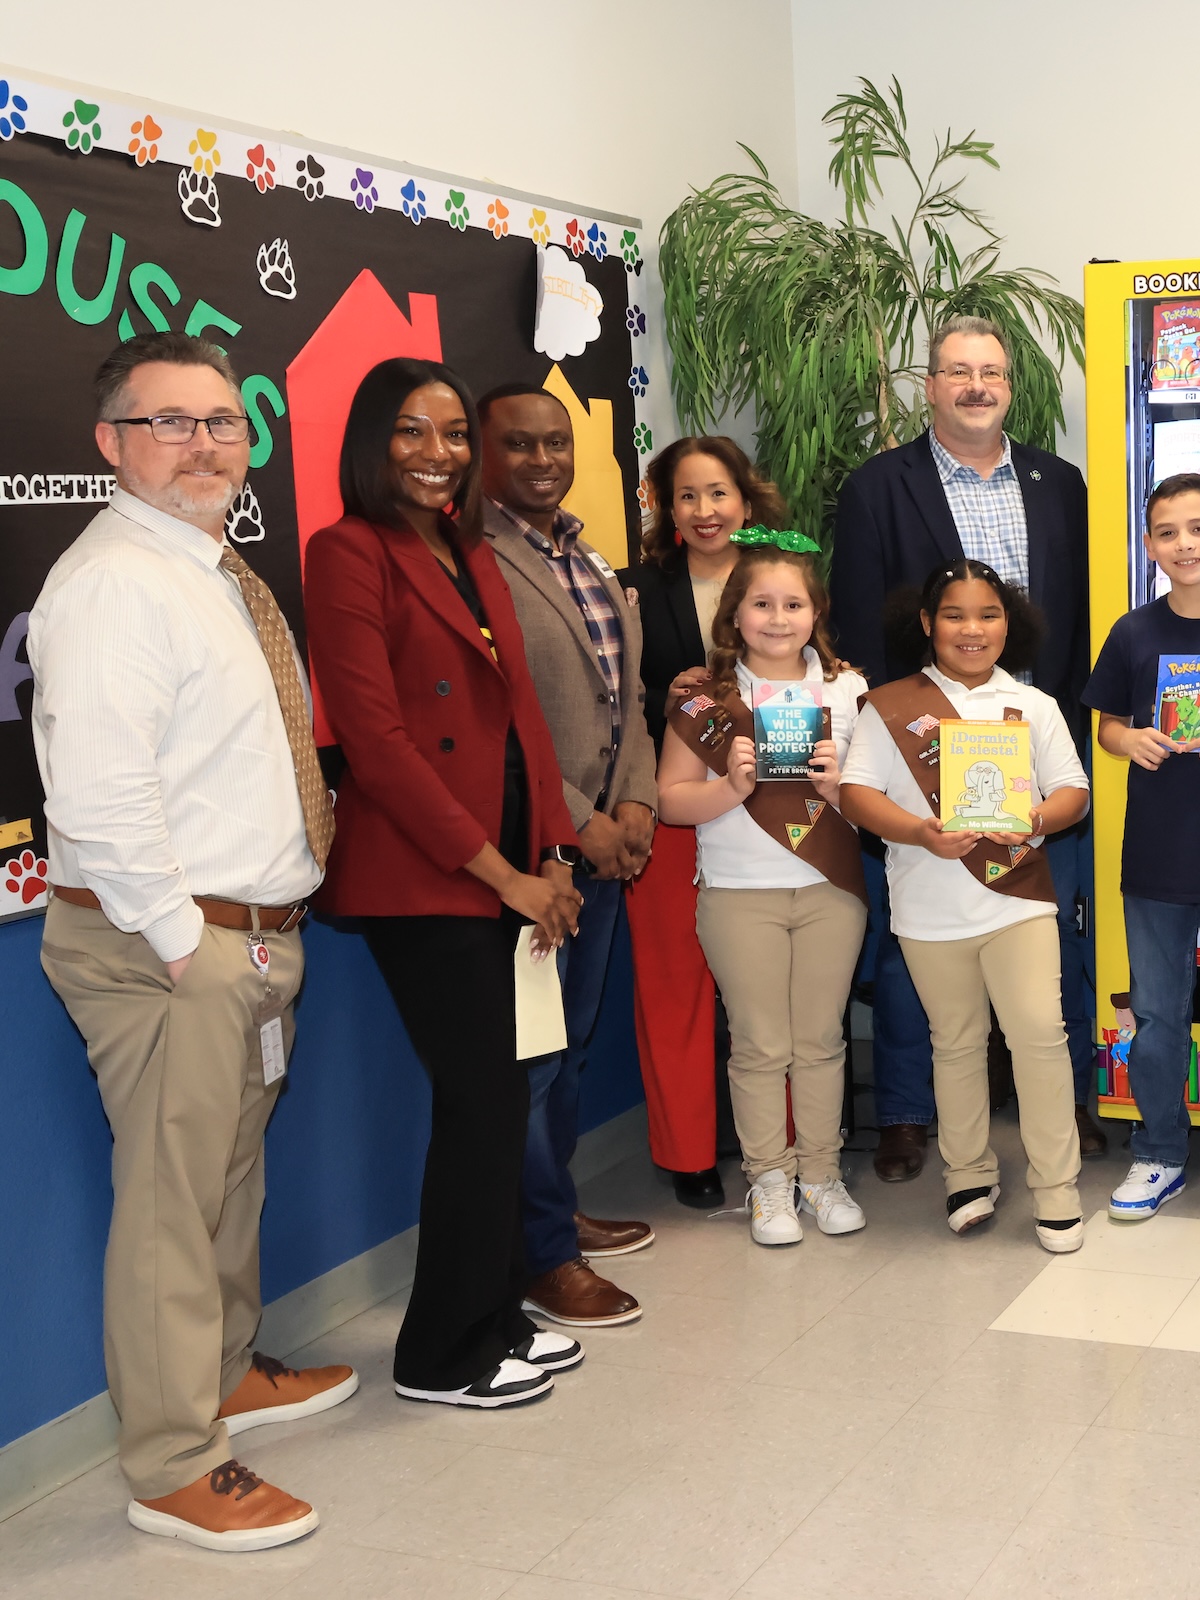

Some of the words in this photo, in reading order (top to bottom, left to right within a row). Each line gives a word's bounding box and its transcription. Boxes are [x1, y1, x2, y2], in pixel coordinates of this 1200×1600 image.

[0, 474, 117, 503] TOGETHE
[1165, 684, 1194, 693] Scyther,
[777, 709, 801, 718] THE
[772, 720, 807, 730] WILD
[767, 731, 813, 742] ROBOT
[952, 732, 1018, 743] ¡Dormiré
[951, 743, 964, 754] la
[969, 744, 1018, 755] siesta!
